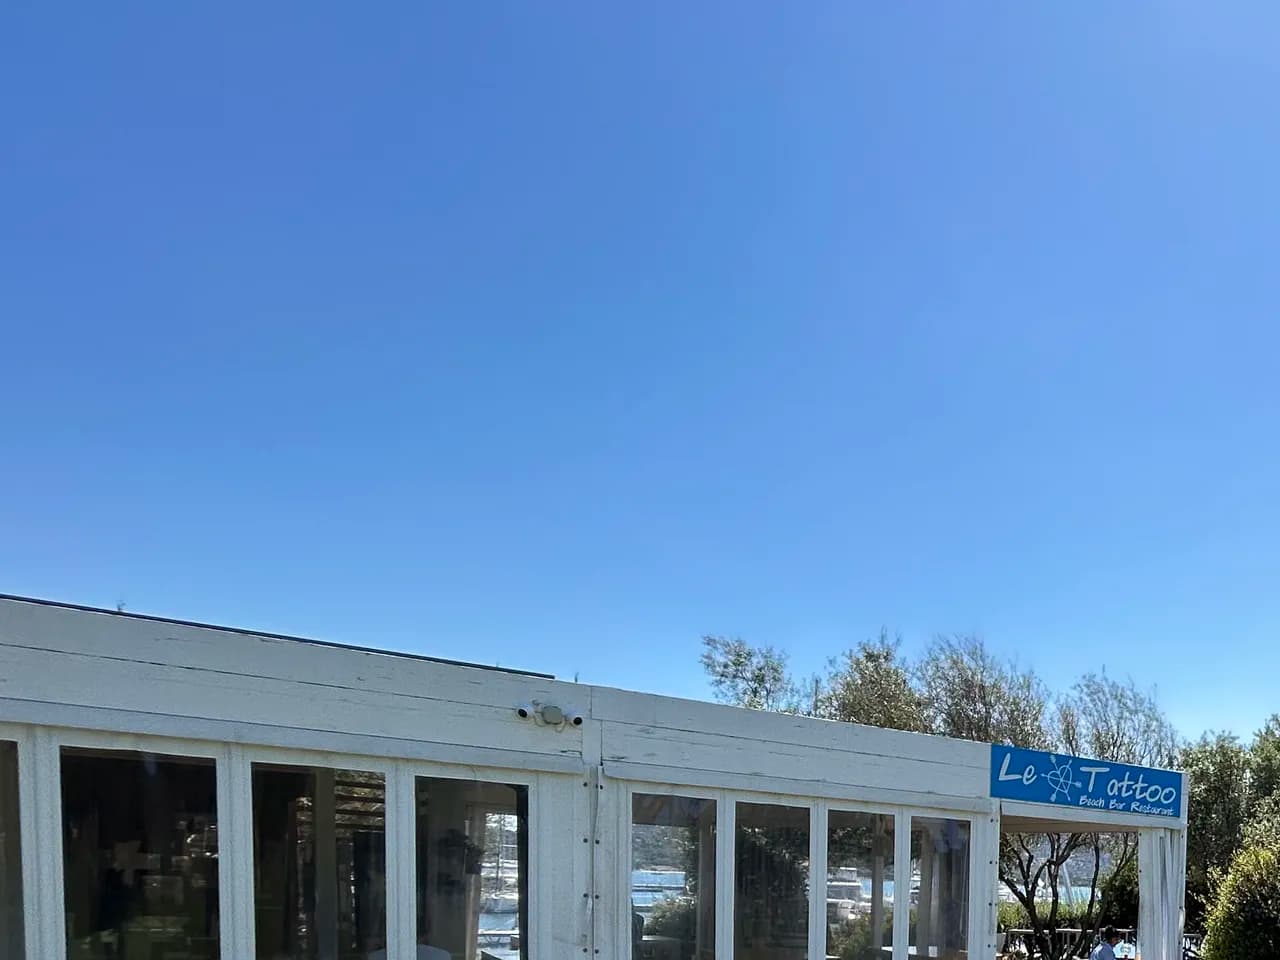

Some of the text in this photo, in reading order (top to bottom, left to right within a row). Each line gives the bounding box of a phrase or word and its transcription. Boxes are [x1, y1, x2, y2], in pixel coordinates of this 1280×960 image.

[998, 753, 1176, 804] Le Tattoo
[1079, 795, 1174, 816] Beach Bar Restaurant
